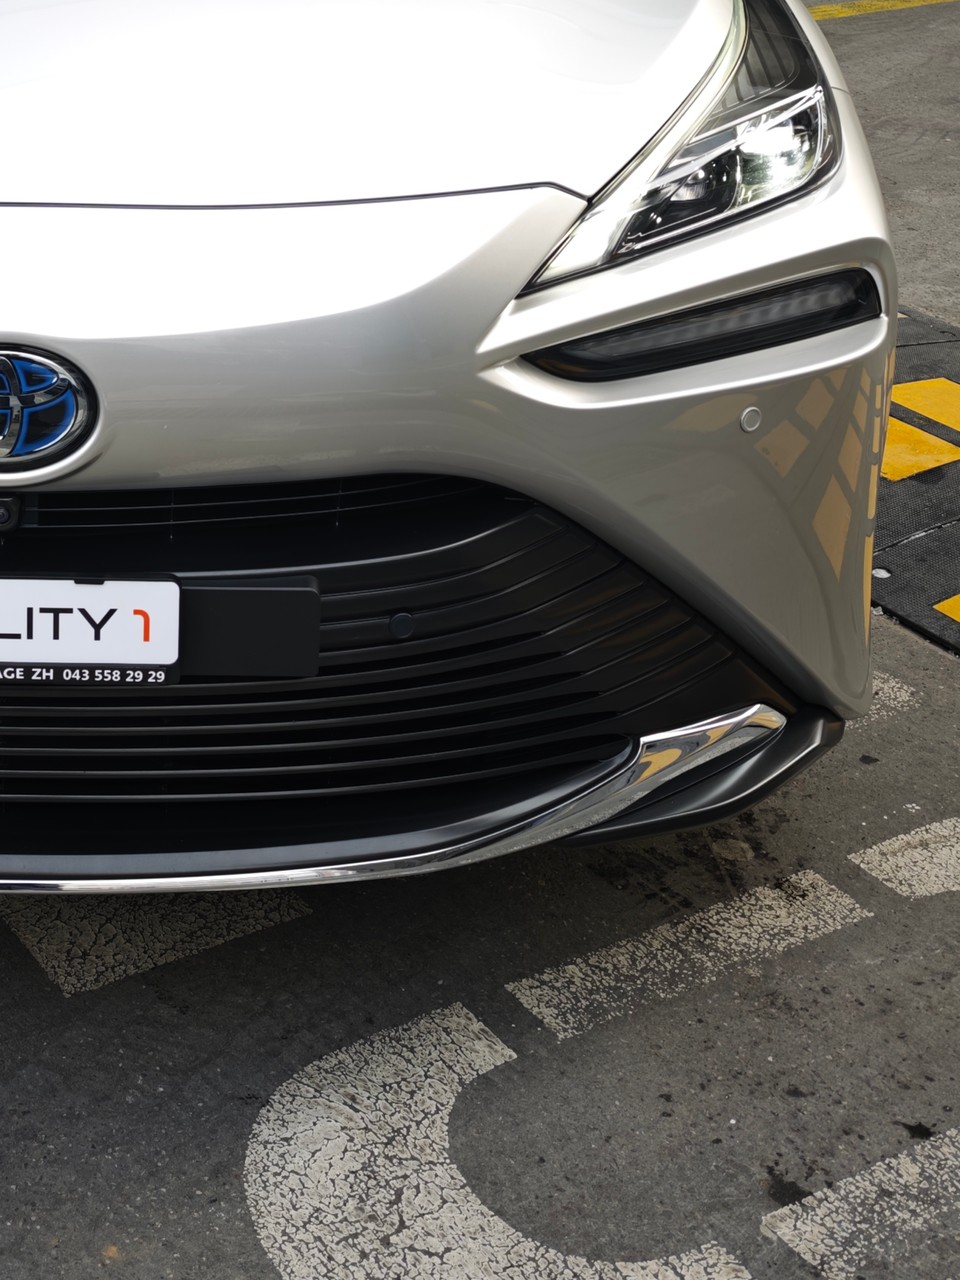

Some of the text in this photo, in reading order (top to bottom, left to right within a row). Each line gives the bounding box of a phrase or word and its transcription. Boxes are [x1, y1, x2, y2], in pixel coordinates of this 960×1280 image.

[133, 609, 151, 642] 1
[30, 667, 55, 681] ZH
[62, 668, 91, 682] 043
[94, 668, 121, 682] 558
[125, 669, 144, 683] 29
[147, 669, 166, 683] 29
